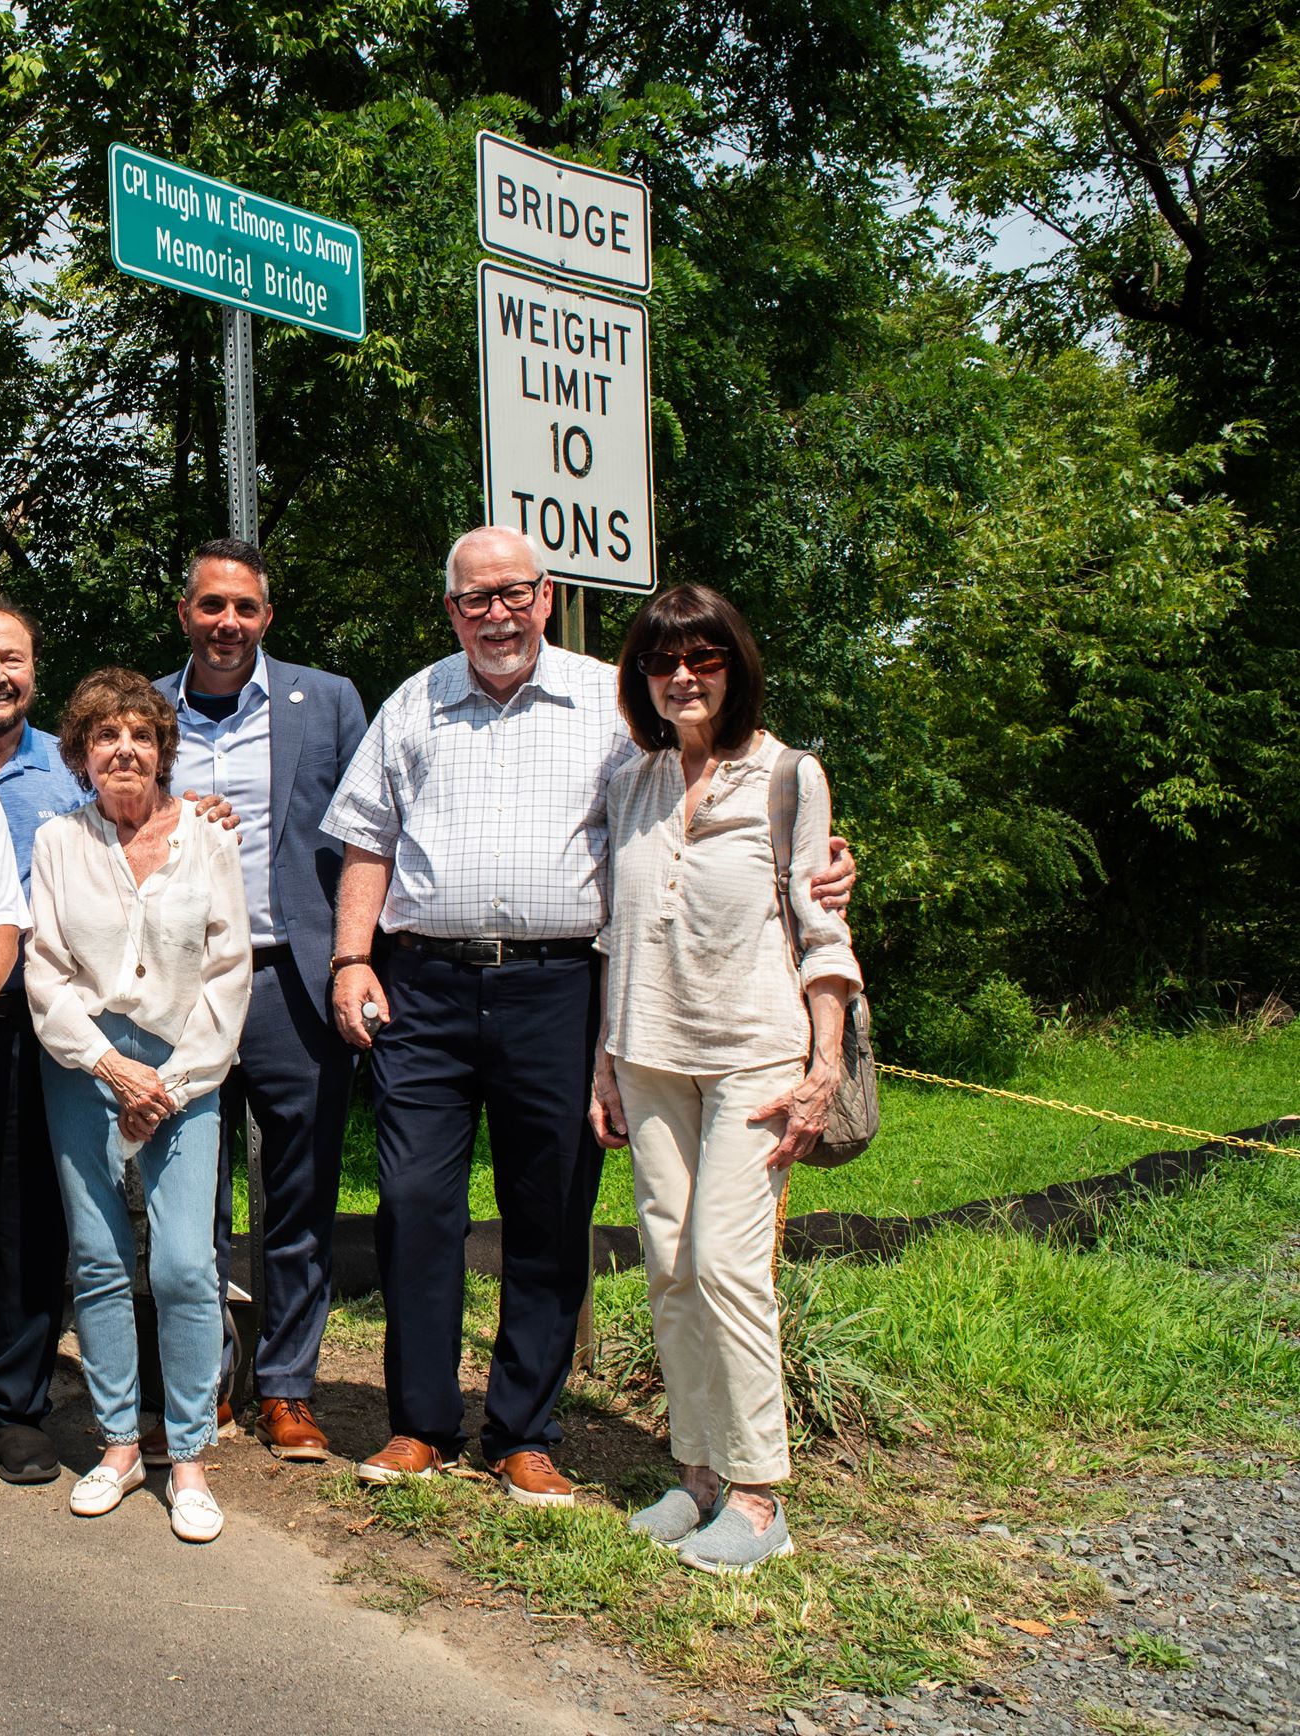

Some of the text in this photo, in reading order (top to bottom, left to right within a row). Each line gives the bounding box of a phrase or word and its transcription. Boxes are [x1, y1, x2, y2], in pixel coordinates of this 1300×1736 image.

[122, 162, 353, 276] CPL Hugh W. Elmore, US Army
[497, 174, 631, 254] BRIDGE
[156, 226, 328, 317] Memorial Bridge
[498, 292, 631, 366] WEIGHT
[521, 356, 612, 416] LIMIT
[550, 422, 593, 479] 10
[511, 490, 631, 562] TONS
